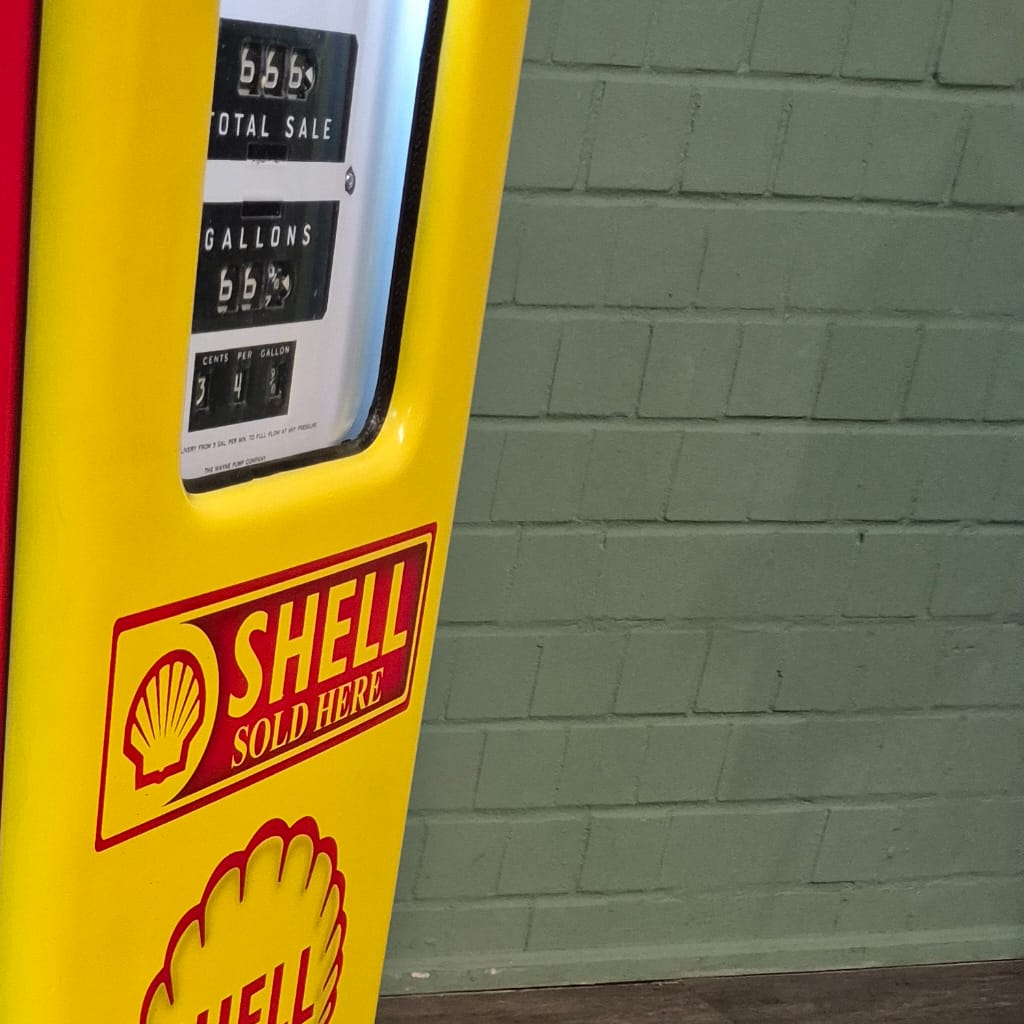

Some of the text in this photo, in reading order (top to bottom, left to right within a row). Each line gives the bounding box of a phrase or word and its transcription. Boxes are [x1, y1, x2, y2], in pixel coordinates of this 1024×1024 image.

[211, 111, 333, 140] OTAL SALE
[204, 223, 312, 251] GALLONS
[202, 345, 290, 366] CENTS PER GALLON
[227, 561, 408, 719] SHELL
[231, 667, 385, 770] SOLD HERE
